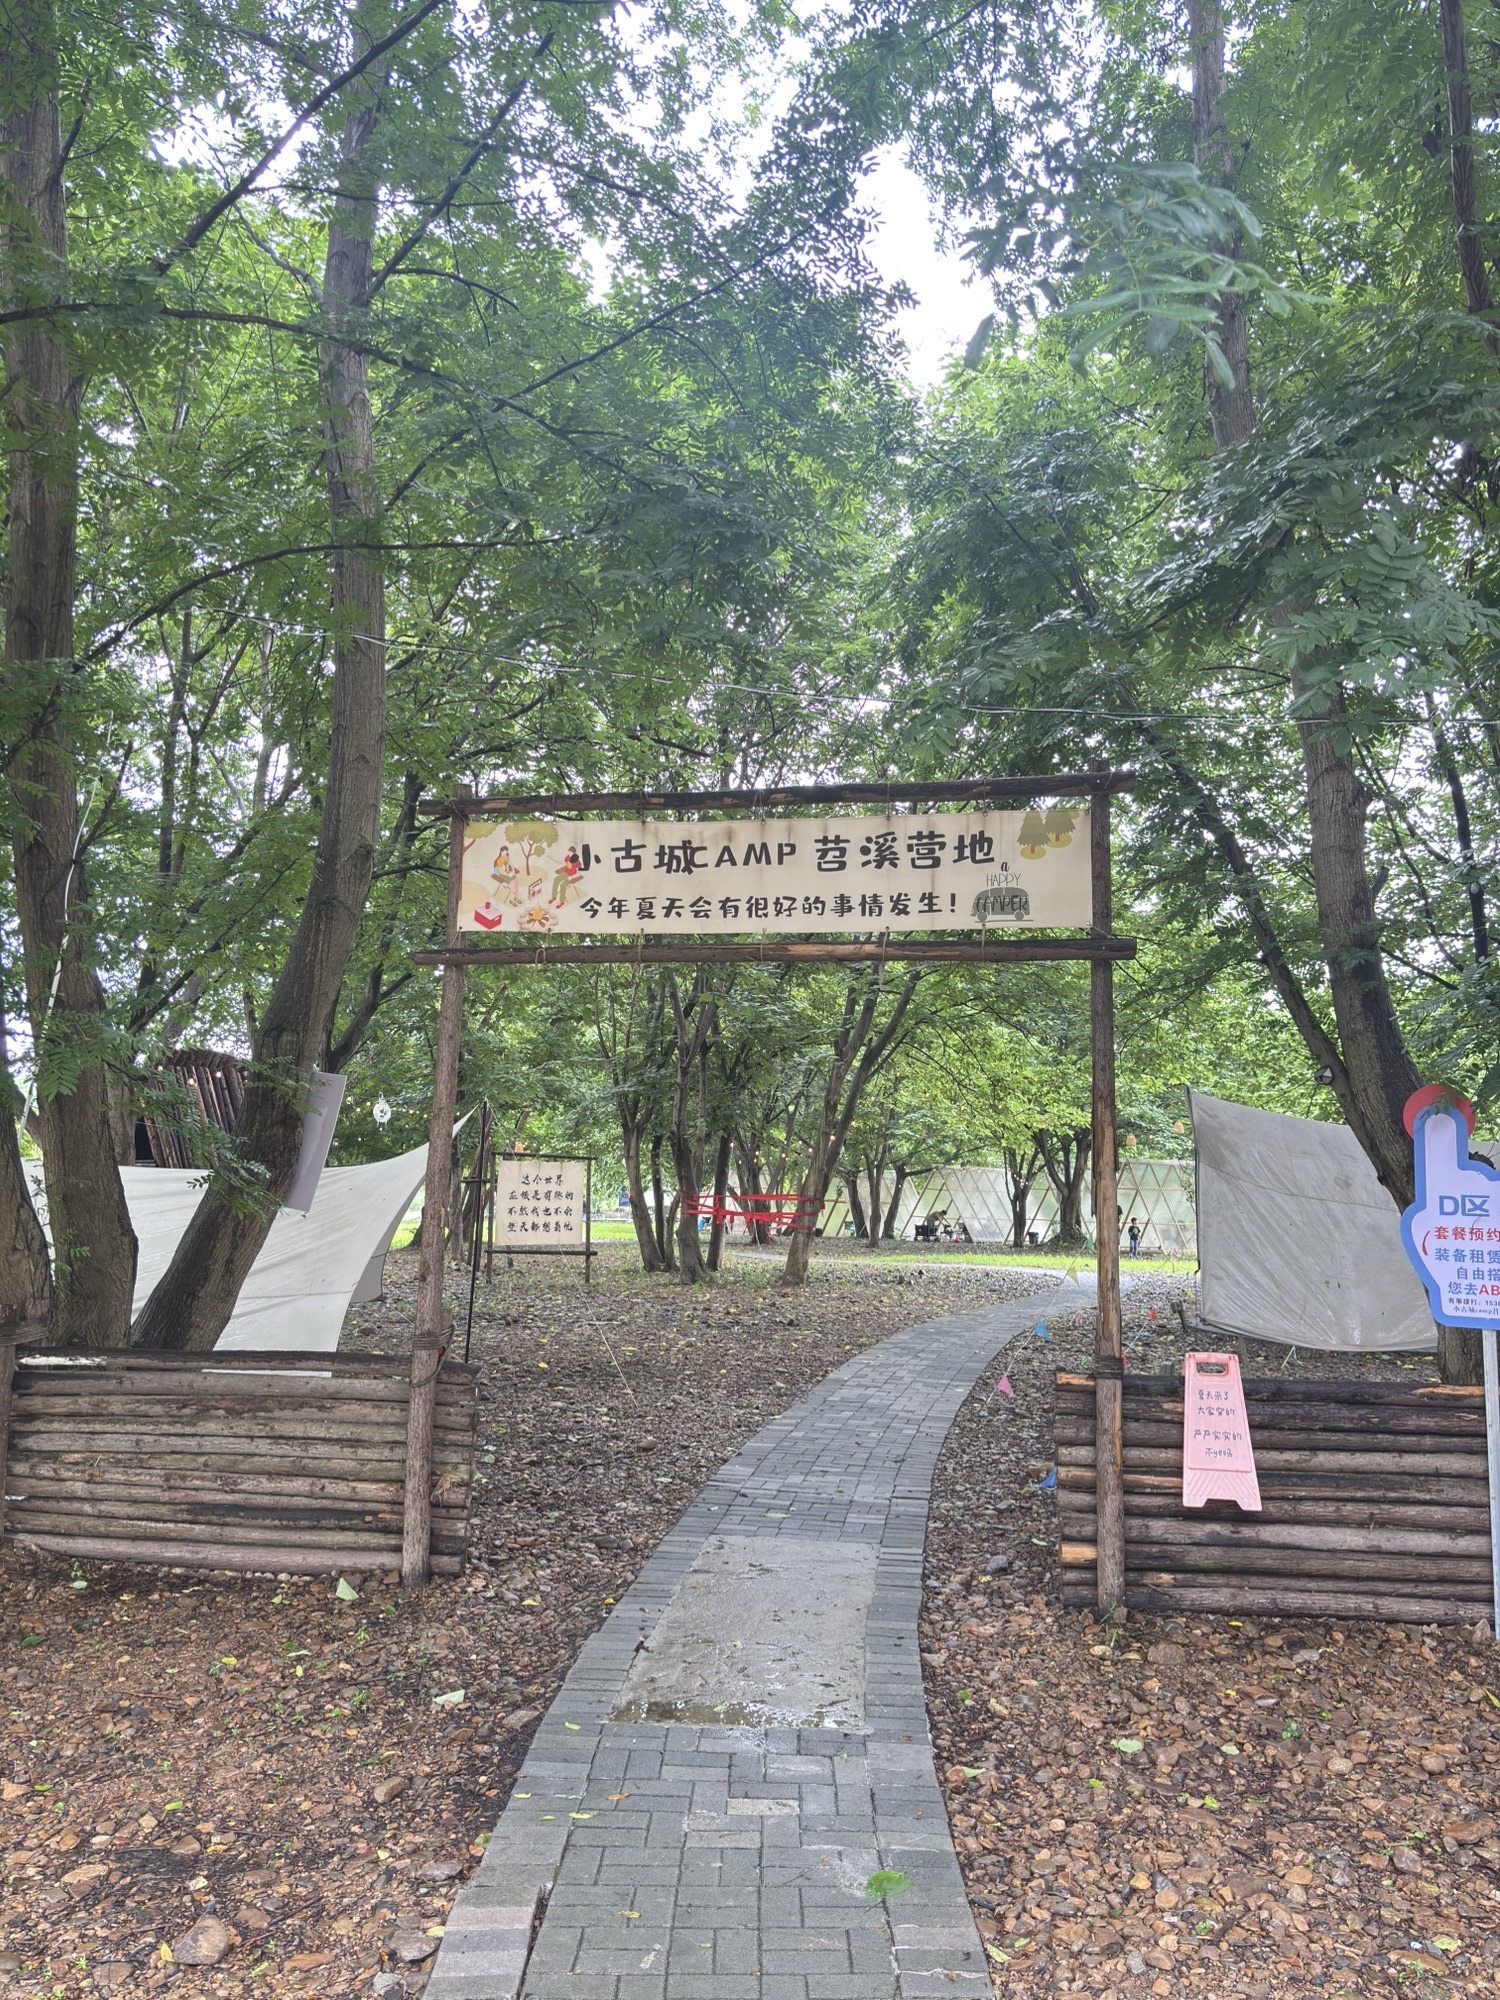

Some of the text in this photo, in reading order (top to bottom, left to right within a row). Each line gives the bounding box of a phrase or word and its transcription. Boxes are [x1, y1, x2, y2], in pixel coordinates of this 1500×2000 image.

[814, 830, 995, 872] 苕溪营地
[1000, 861, 1010, 872] a
[986, 872, 1021, 887] HAPPY
[976, 894, 1028, 913] CAMPER
[521, 1173, 563, 1186] 这个世界
[509, 1189, 573, 1202] 应该是有趣的
[1439, 1194, 1490, 1217] D区
[1434, 1226, 1500, 1242] 套餐预约
[1435, 1247, 1500, 1264] 装备租赁
[1448, 1281, 1500, 1296] 您去AB
[1198, 1389, 1228, 1400] 夏天来了
[1193, 1429, 1242, 1441] 严严实实的
